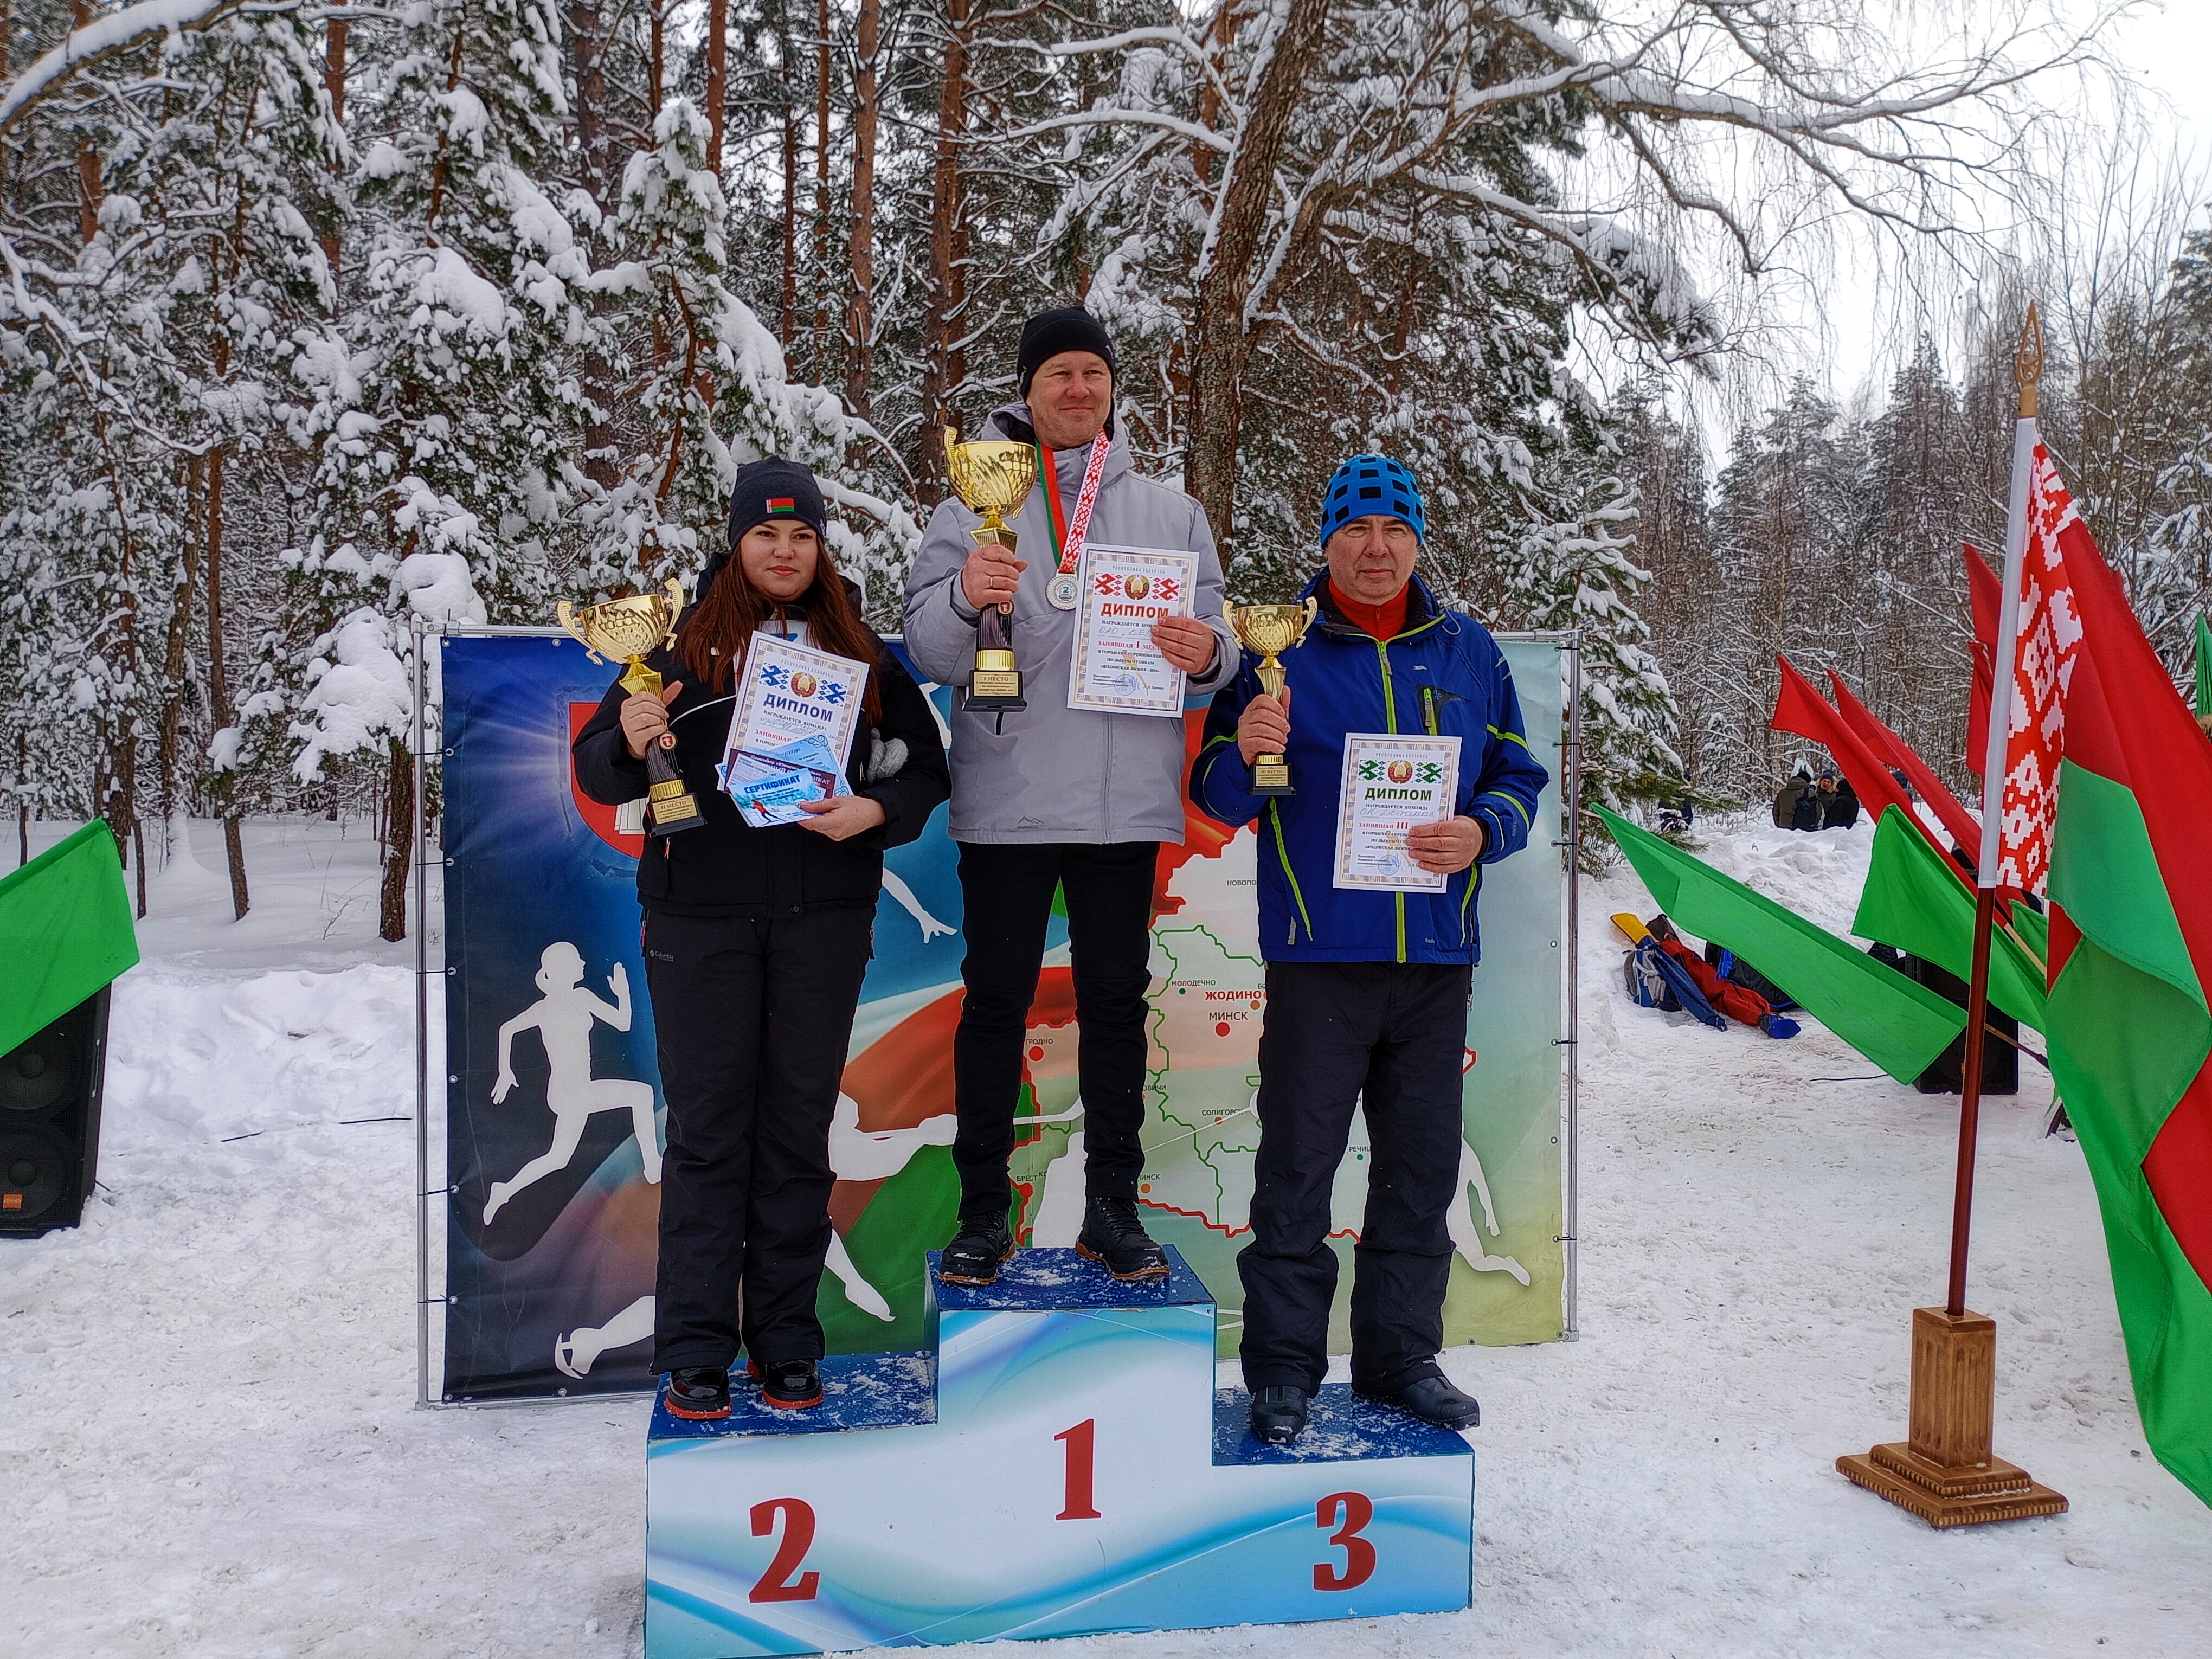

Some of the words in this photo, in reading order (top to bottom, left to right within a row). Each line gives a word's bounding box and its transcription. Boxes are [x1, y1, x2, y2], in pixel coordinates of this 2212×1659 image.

[1101, 602, 1169, 619] ДИПЛОМ
[1098, 641, 1133, 649] ЗАНЯВШАЯ
[763, 693, 834, 723] ДИПЛОМ
[763, 710, 802, 724] НАГРАЖДАЕТСЯ
[744, 774, 801, 794] СЕРТИФИКАТ
[1364, 787, 1432, 801] ДИПЛОМ
[666, 800, 687, 808] МЕСТО
[1205, 990, 1262, 1001] ЖОДИНО
[1208, 1012, 1249, 1021] МИНСК
[1054, 1418, 1101, 1520] 1
[1314, 1491, 1376, 1591] 3
[749, 1497, 820, 1603] 2
